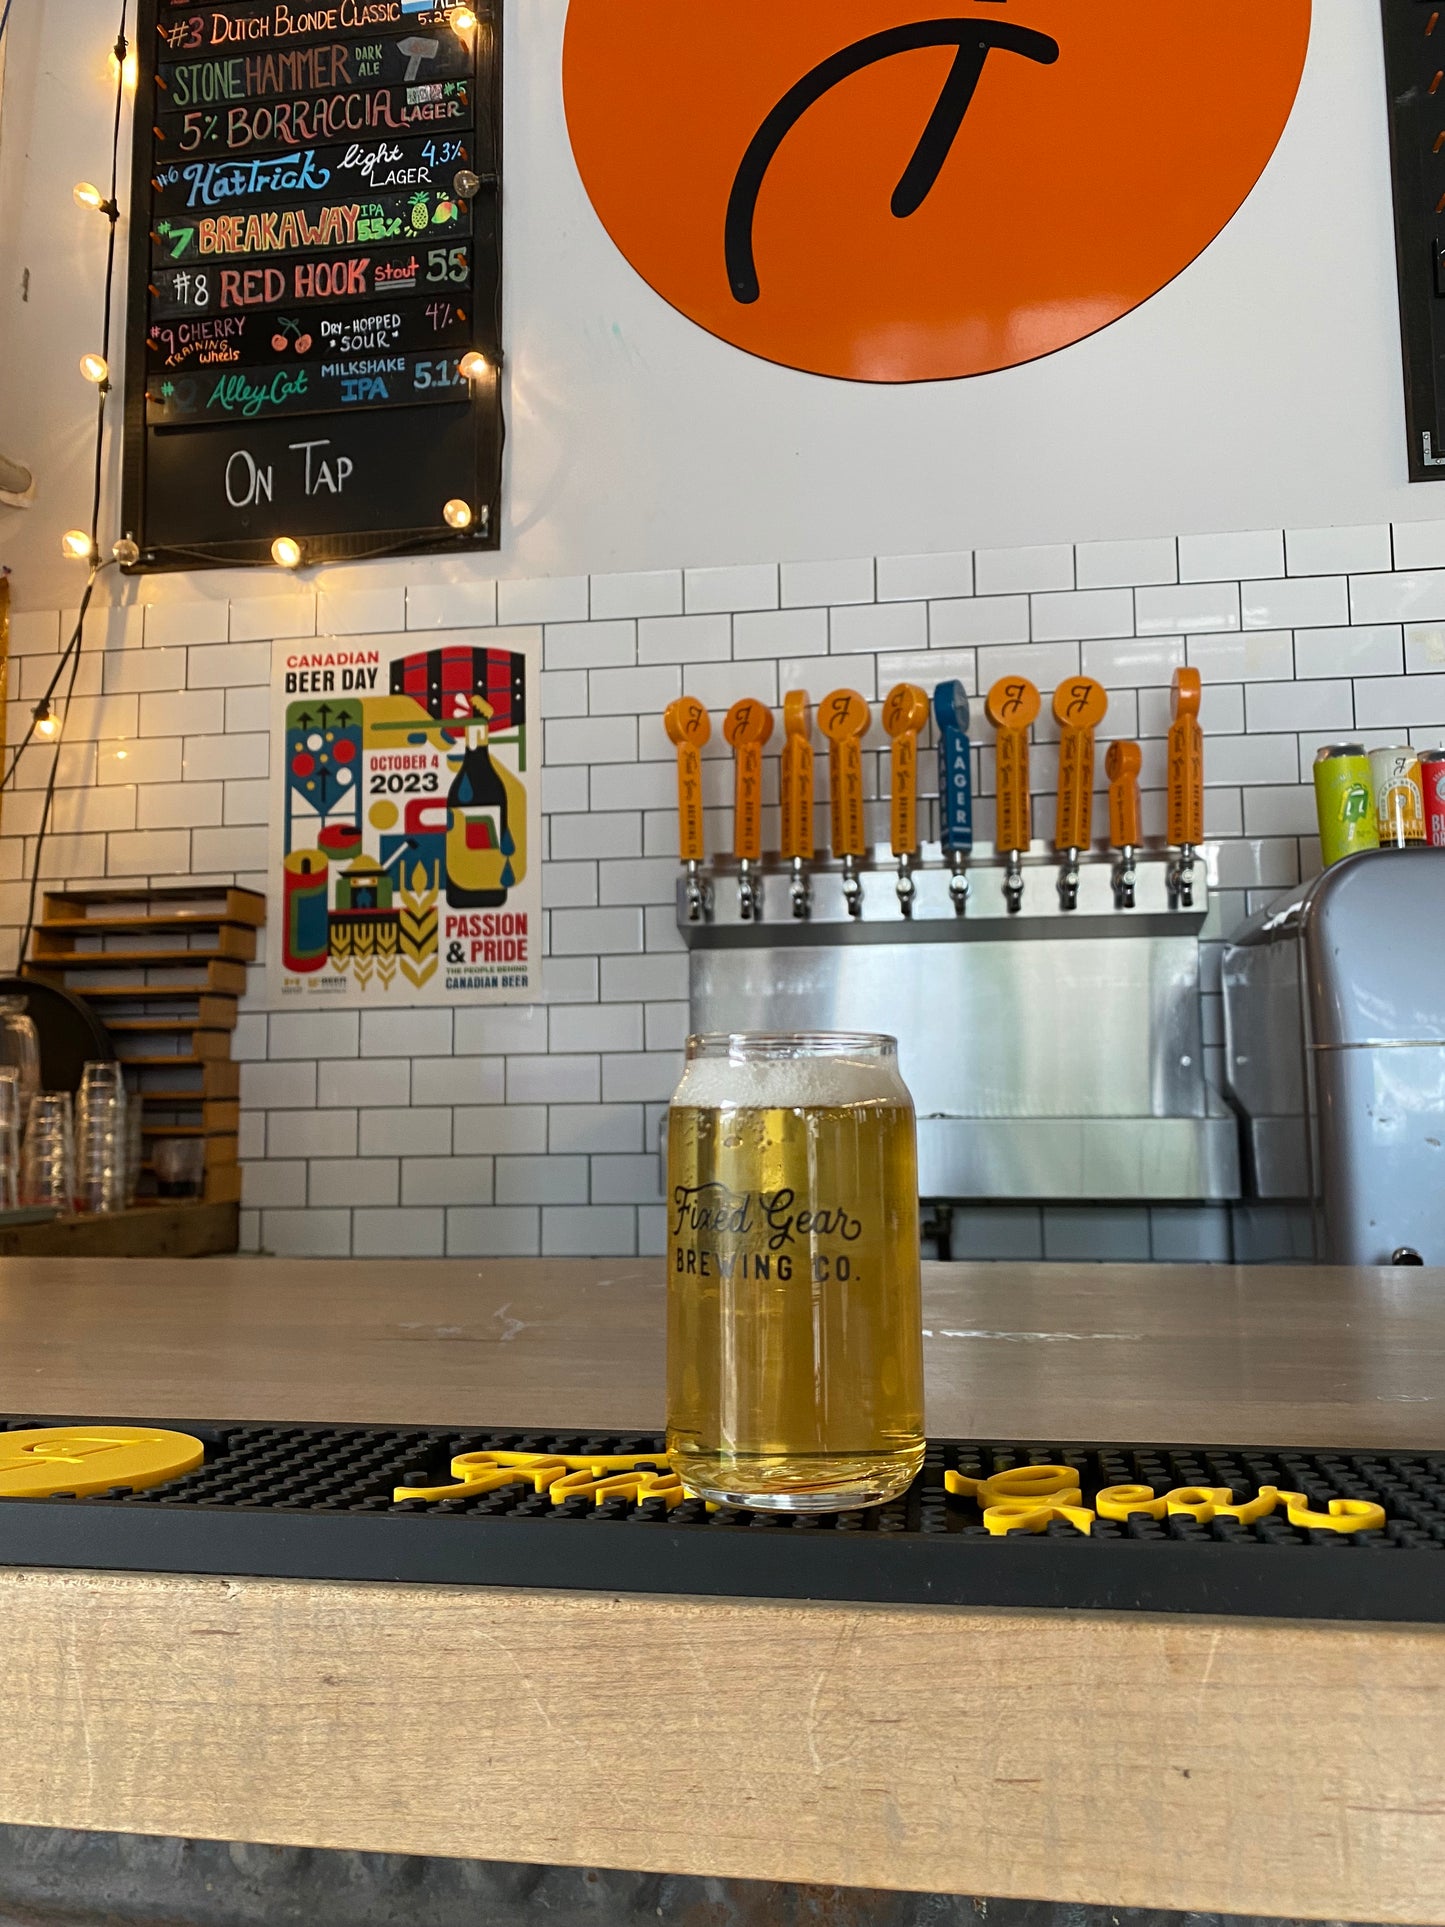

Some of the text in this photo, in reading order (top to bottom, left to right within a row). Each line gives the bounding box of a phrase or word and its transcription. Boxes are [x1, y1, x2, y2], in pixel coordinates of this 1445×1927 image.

[167, 0, 400, 48] #3 DUTCH BLONDE CLASSIC
[355, 44, 383, 60] DARK
[358, 62, 380, 77] ALE
[179, 112, 219, 150] 5%
[226, 89, 410, 149] BORRACCIA
[400, 100, 465, 122] LAGER
[336, 139, 462, 176] light 4.3%
[369, 166, 432, 188] LAGER
[360, 203, 385, 218] IPA
[157, 203, 360, 260] #7 BREAKAWAY
[173, 271, 210, 306] #8
[219, 268, 285, 309] RED
[294, 257, 371, 299] HOOK
[374, 255, 420, 281] stout
[425, 302, 453, 331] 4%
[150, 315, 246, 354] #9 CHERRY
[339, 330, 390, 352] SOUR
[165, 339, 228, 367] TRAINING
[321, 357, 406, 377] MILKSHAKE
[340, 376, 389, 402] IPA
[286, 650, 380, 669] CANADIAN
[285, 667, 379, 693] BEER DAY
[370, 754, 439, 771] OCTOBER 4
[370, 771, 439, 794] 2023
[953, 737, 967, 823] LAGER
[446, 913, 528, 938] PASSION
[446, 939, 528, 964] & PRIDE
[446, 965, 528, 974] THE PEOPLE BEHIND
[446, 974, 529, 989] CANADIAN BEER
[674, 1181, 862, 1250] Fixed Gear
[677, 1247, 862, 1283] BREWING CO.
[944, 1464, 1386, 1536] Gear
